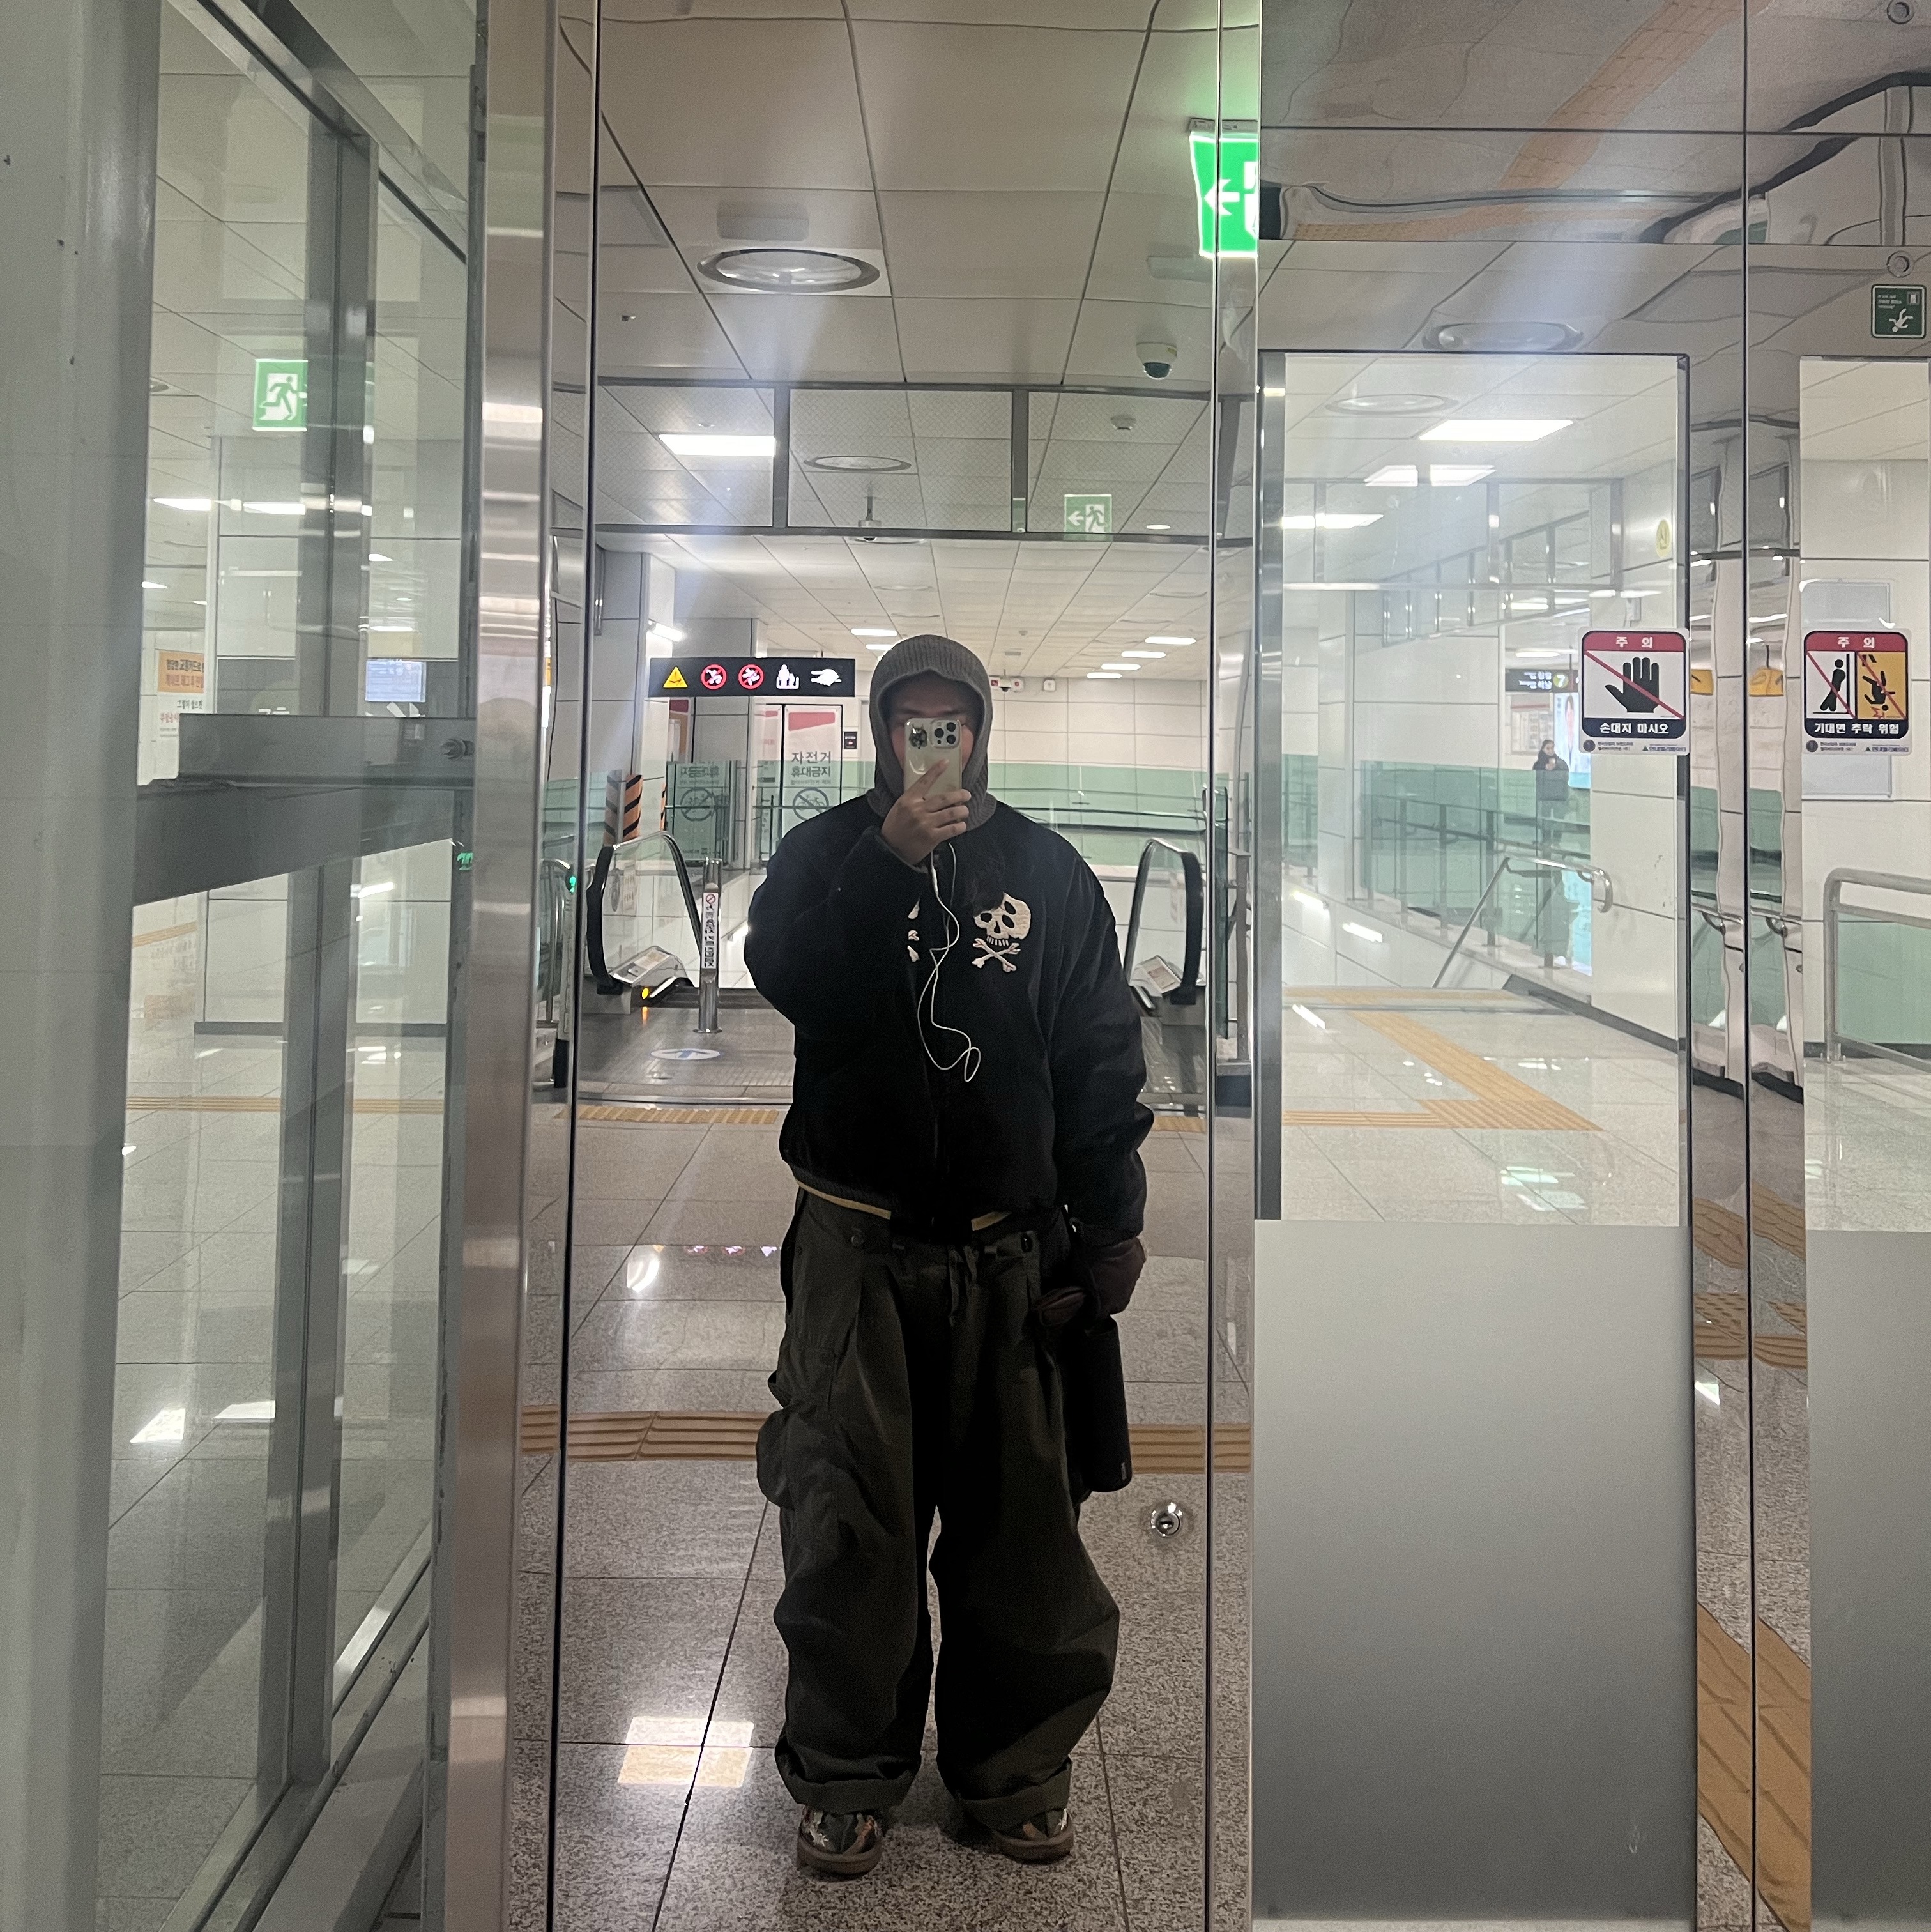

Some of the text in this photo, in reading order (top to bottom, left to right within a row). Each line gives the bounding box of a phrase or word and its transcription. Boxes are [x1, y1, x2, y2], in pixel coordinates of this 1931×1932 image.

[1557, 674, 1566, 687] 7
[1600, 723, 1669, 734] 손대지 마시오
[1814, 723, 1899, 734] 기대면 추락 위험
[791, 751, 831, 764] 자전거
[791, 766, 831, 778] 휴대금지
